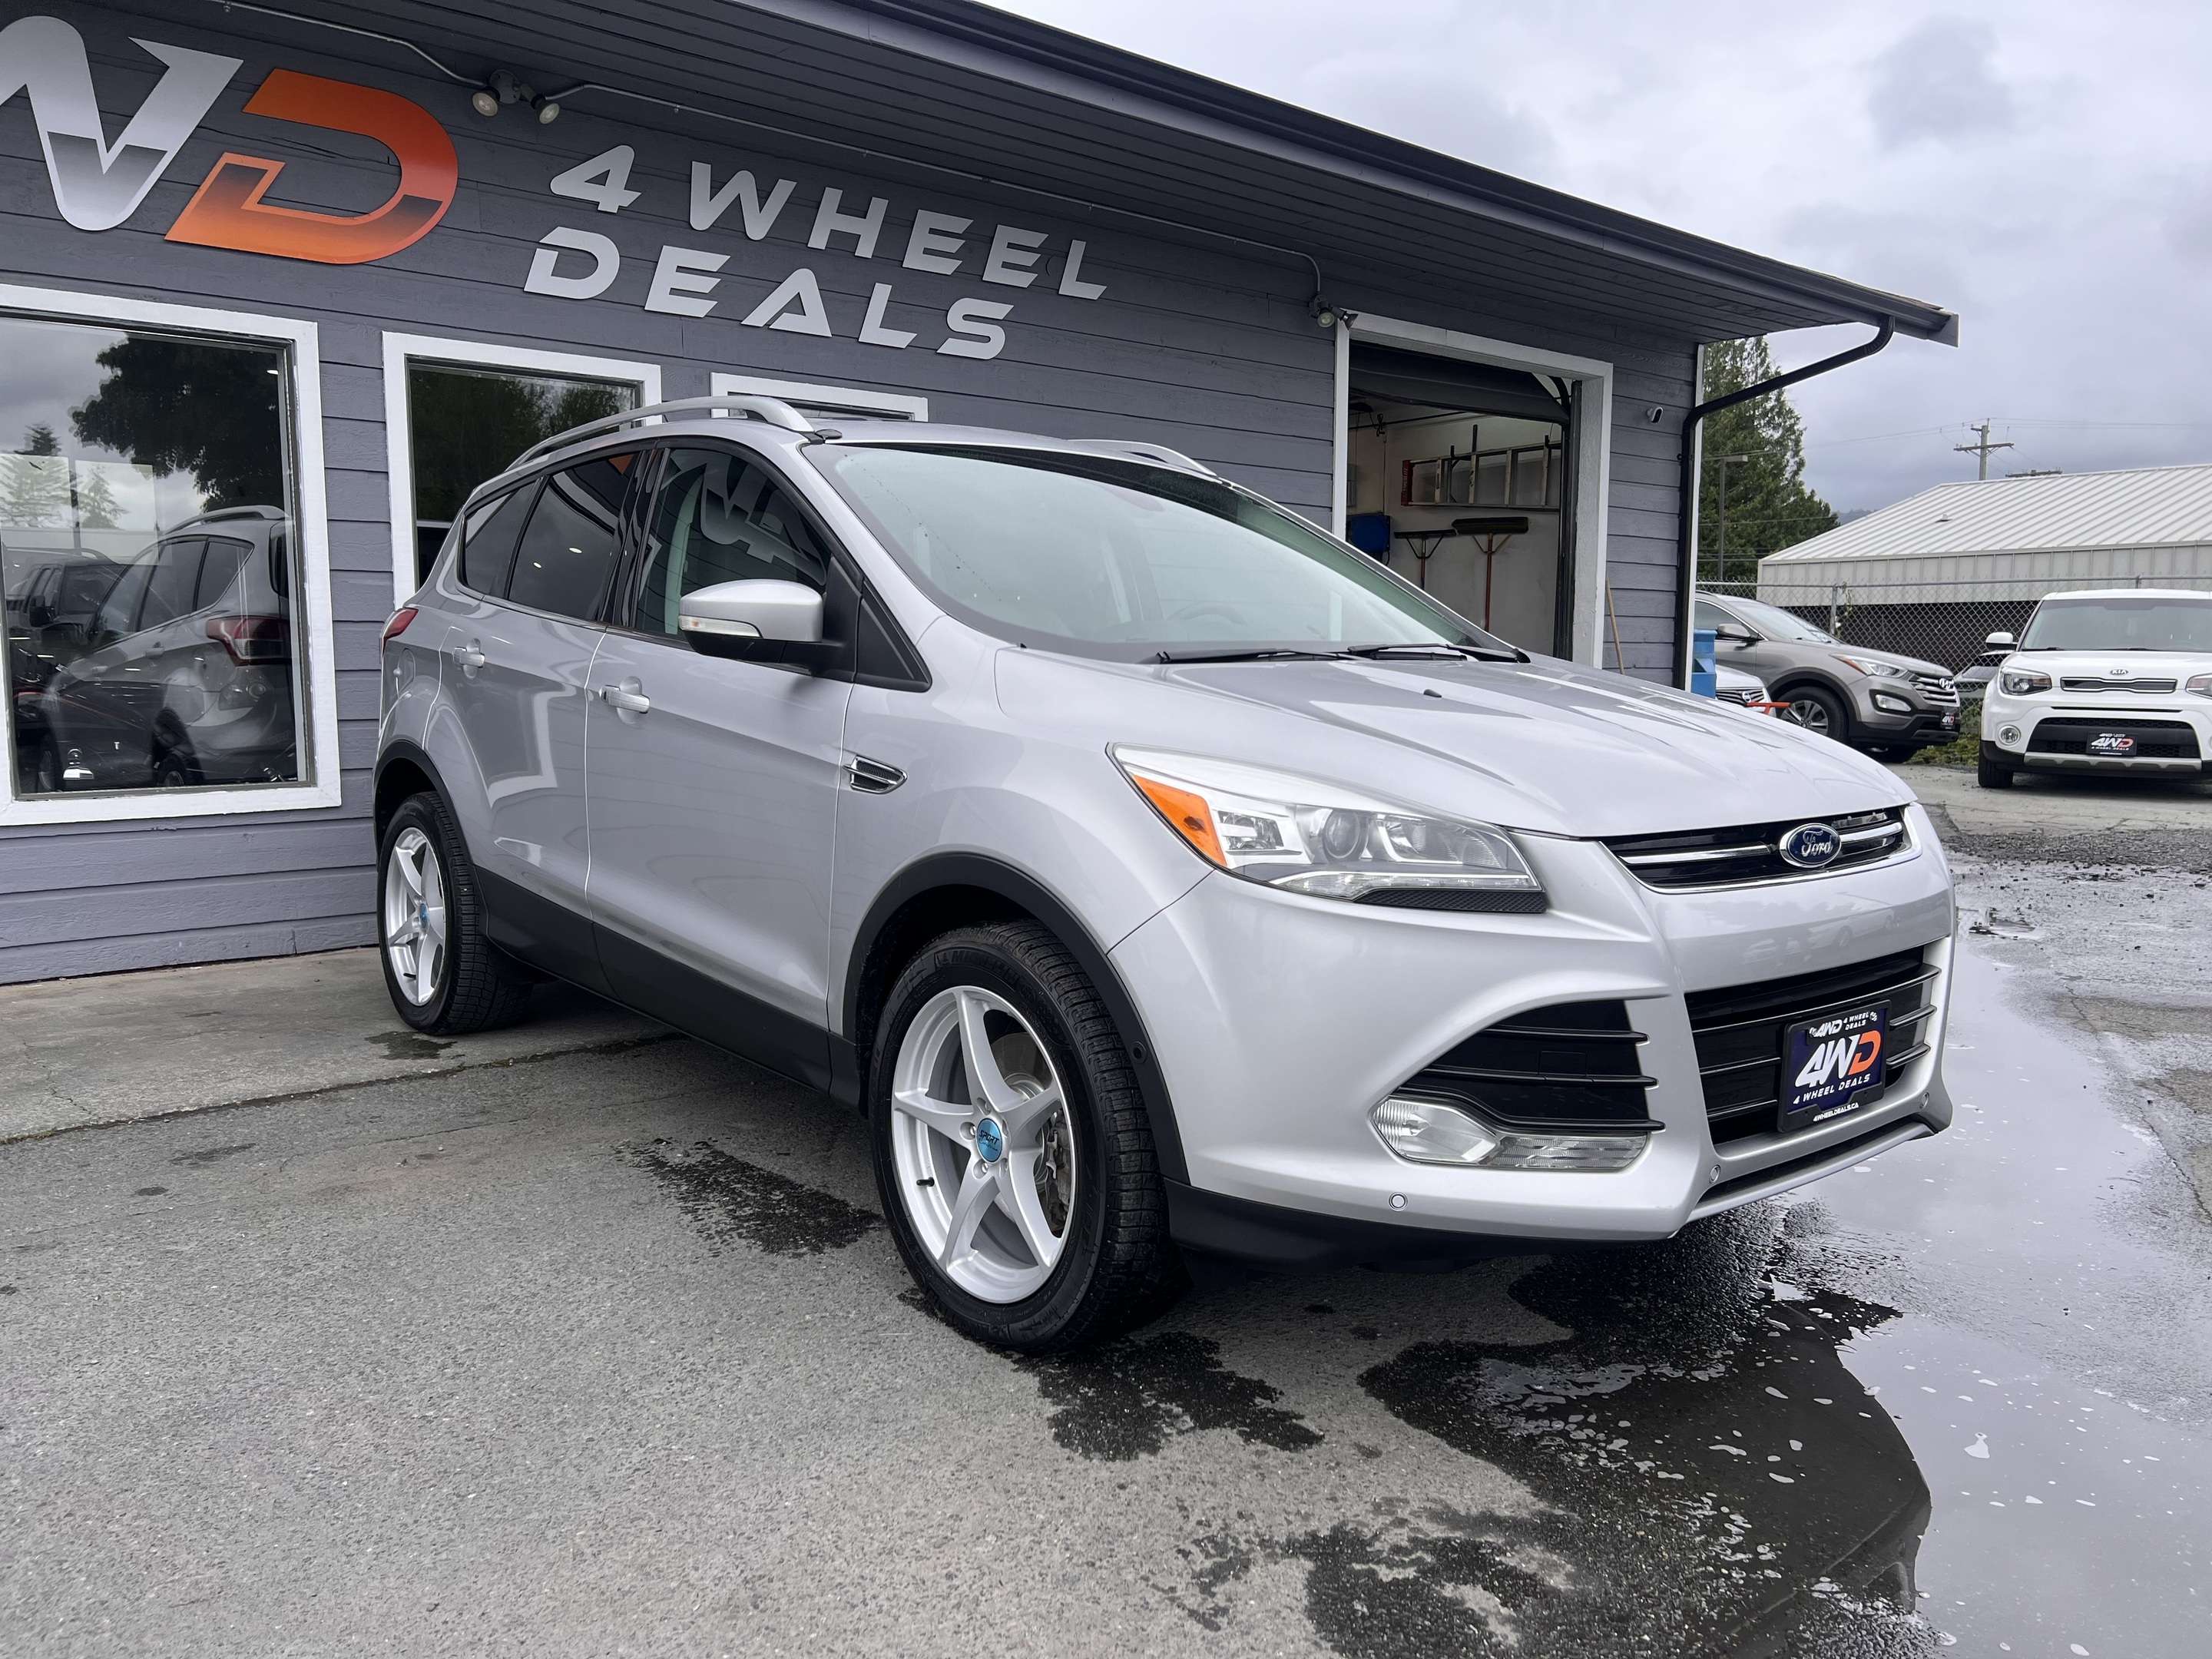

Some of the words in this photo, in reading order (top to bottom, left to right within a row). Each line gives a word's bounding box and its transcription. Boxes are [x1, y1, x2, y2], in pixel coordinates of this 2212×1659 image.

[549, 144, 642, 214] 4
[689, 161, 1108, 300] WHEEL
[524, 226, 1015, 360] DEALS
[2091, 737, 2134, 748] 4WD
[1801, 830, 1833, 857] Ford
[1845, 1019, 1866, 1030] DEALS
[1849, 1012, 1869, 1022] WHEEL
[1794, 1030, 1881, 1088] 4WD
[1793, 1095, 1800, 1104] 4
[1803, 1084, 1835, 1102] WHEEL
[1838, 1074, 1871, 1091] DEALS
[979, 1130, 999, 1144] SPORT
